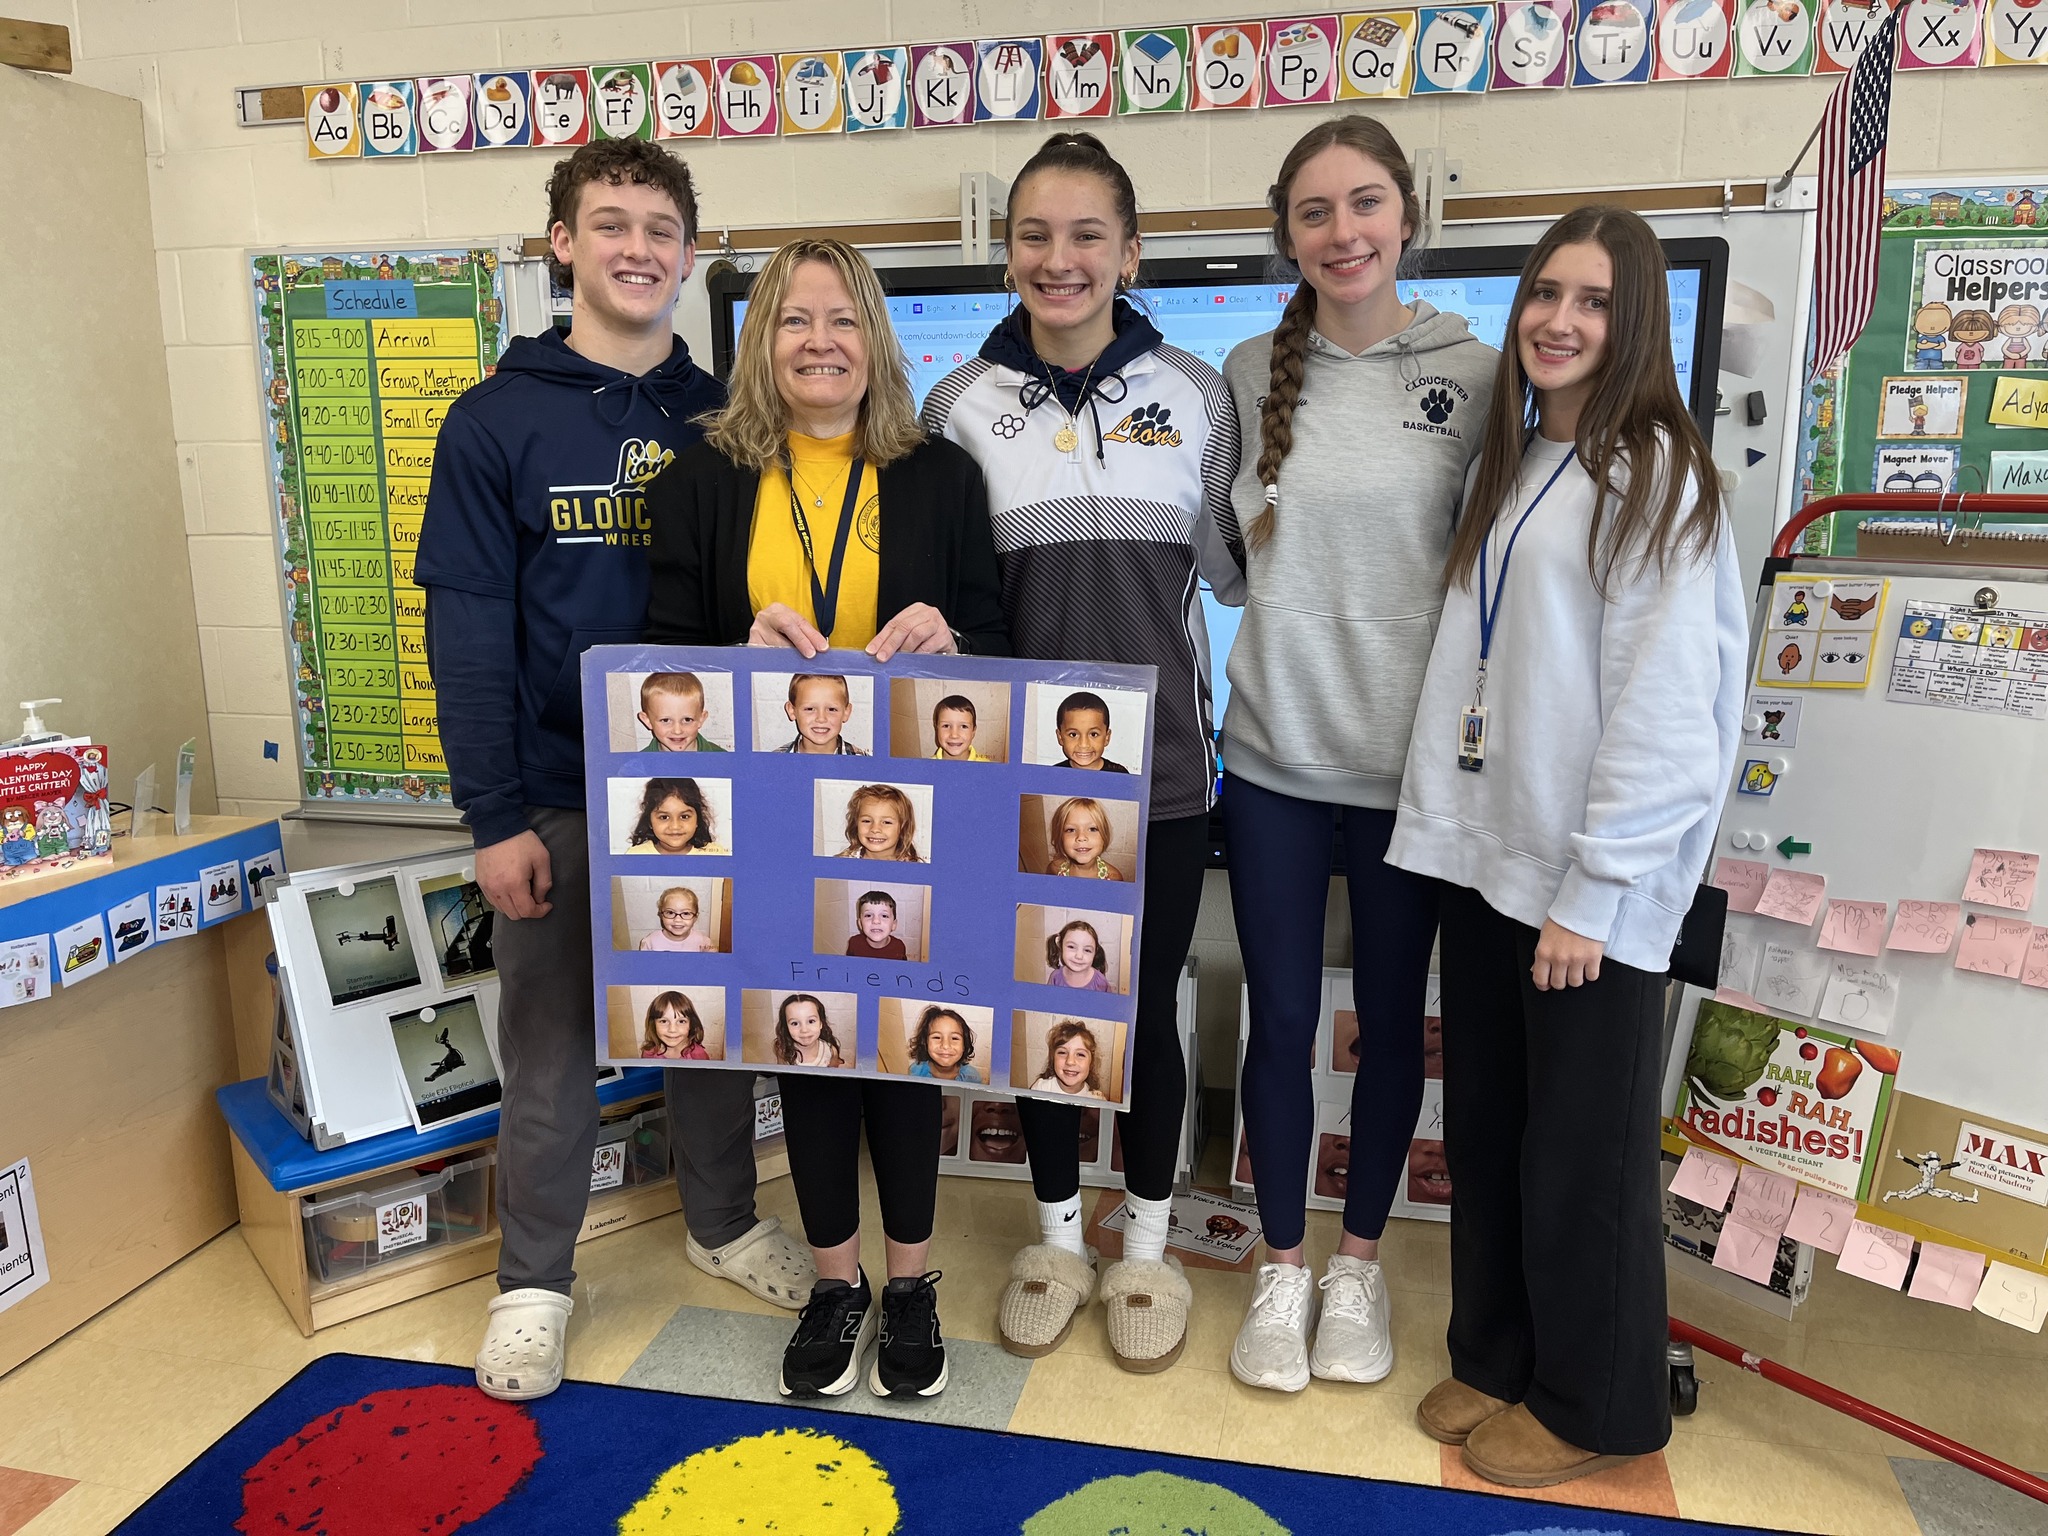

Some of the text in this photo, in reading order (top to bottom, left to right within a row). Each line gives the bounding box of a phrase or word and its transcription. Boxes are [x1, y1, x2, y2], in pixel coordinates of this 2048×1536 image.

[1672, 28, 1713, 60] Uu
[1755, 24, 1792, 57] Vv
[1918, 16, 1960, 48] Xx
[2005, 12, 2047, 57] Yy
[1434, 42, 1470, 73] Rr
[1514, 37, 1548, 69] Ss
[1591, 32, 1633, 64] Tt
[1132, 64, 1171, 96] Nn
[1206, 60, 1245, 91] Oo
[1281, 54, 1318, 98] Pp
[1352, 49, 1399, 89] Qq
[926, 78, 958, 109] Kk
[1054, 70, 1100, 101] Mm
[606, 99, 633, 127] Ff
[663, 93, 698, 134] Gg
[727, 89, 762, 120] Hh
[798, 86, 820, 116] Ii
[857, 83, 885, 125] Jj
[313, 115, 348, 142] Aa
[372, 113, 403, 140] Bb
[428, 109, 461, 135] Cc
[483, 104, 517, 131] Dd
[541, 101, 571, 129] Ee
[1934, 254, 2048, 277] Classroo
[333, 289, 408, 311] Schedule
[377, 327, 436, 348] Arrival
[380, 368, 420, 393] Group
[1405, 376, 1469, 403] GLOUCESTER
[1889, 385, 1958, 398] Pledge Helper
[384, 409, 420, 429] Small
[1103, 413, 1183, 448] Lions
[1402, 420, 1462, 440] BASKETBALL
[388, 448, 432, 467] Choice
[1883, 455, 1948, 466] Magnet Mover
[1947, 665, 1964, 673] What
[15, 761, 48, 773] HAPPY
[51, 769, 73, 780] DAY,
[28, 778, 71, 792] CRITTER!
[345, 974, 374, 985] Stamina
[789, 960, 972, 997] Friends
[449, 1079, 475, 1092] Elliptical
[1766, 1063, 1815, 1090] RAH,
[1786, 1090, 1854, 1135] RAH,
[1687, 1106, 1863, 1165] radishes!
[1755, 1146, 1796, 1163] VEGETABLE
[1797, 1157, 1824, 1169] CHANT
[1962, 1132, 2048, 1177] MAX
[18, 1165, 26, 1179] 2
[1777, 1160, 1848, 1192] by april pulley sayre
[1968, 1165, 2032, 1192] Rachel Isadora
[1970, 1160, 1986, 1170] story
[1998, 1168, 2026, 1181] pictures
[2026, 1175, 2036, 1184] by
[1217, 1201, 1247, 1213] Volume
[391, 1231, 414, 1242] MUSICAL
[589, 1214, 627, 1232] Lakeshore
[1194, 1234, 1214, 1245] Lion
[1215, 1239, 1242, 1252] Voice
[1864, 1240, 1888, 1270] 5
